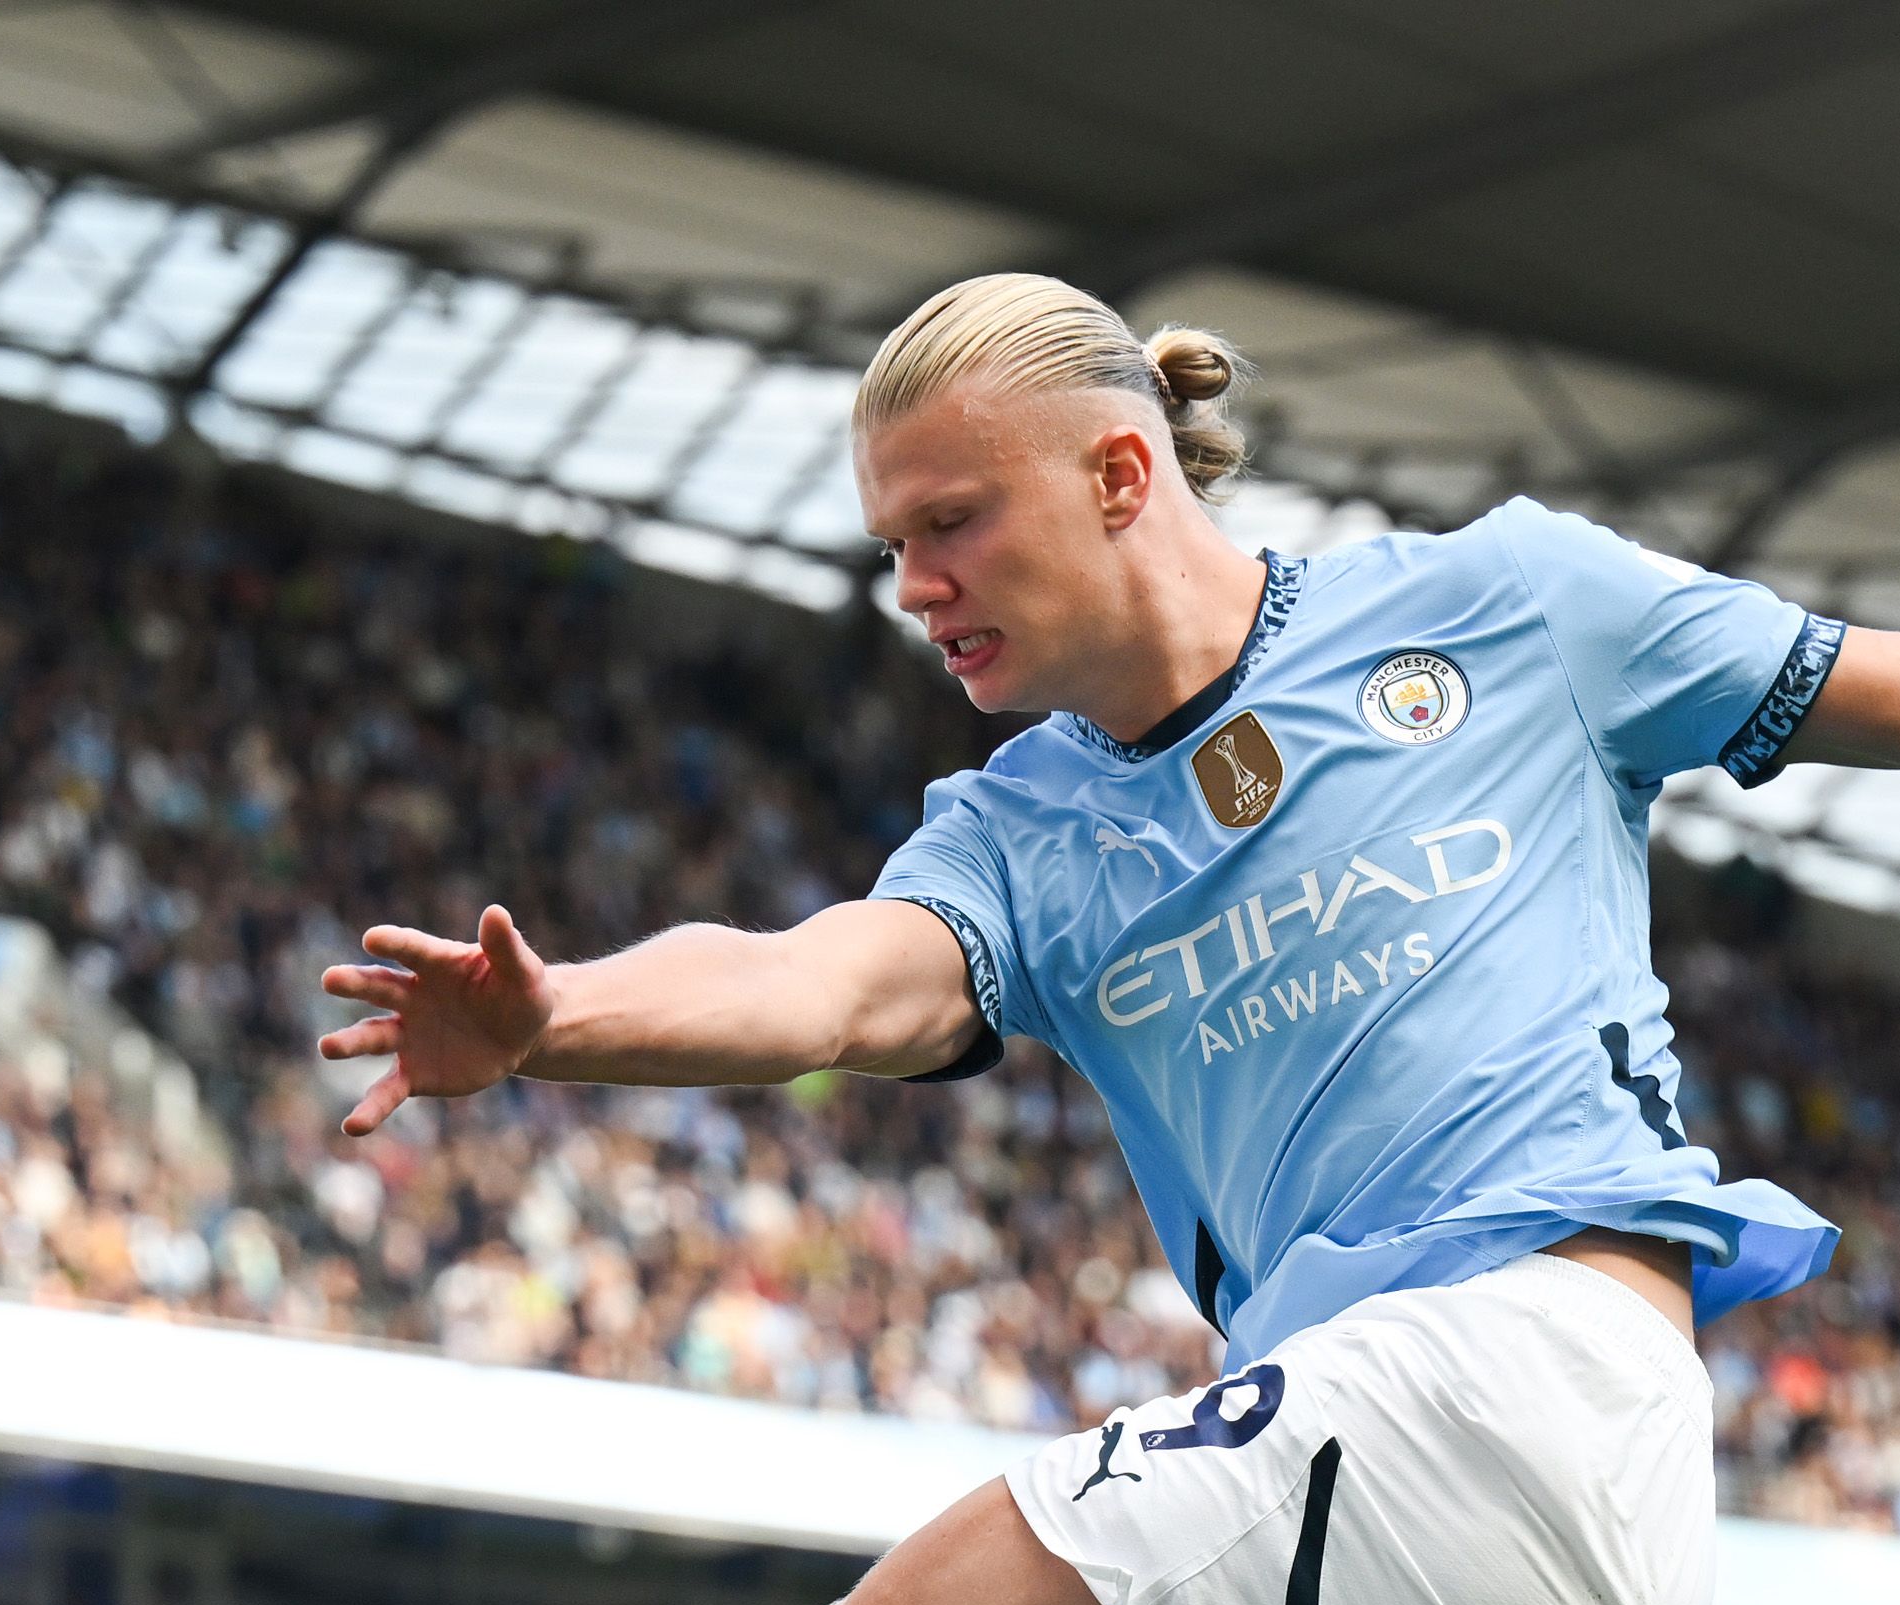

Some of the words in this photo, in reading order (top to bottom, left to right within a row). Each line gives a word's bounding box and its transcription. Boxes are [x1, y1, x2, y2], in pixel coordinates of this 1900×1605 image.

[1366, 657, 1449, 701] MANCHESTER
[1413, 726, 1444, 741] CITY
[1234, 780, 1268, 812] FIFA
[1247, 800, 1266, 819] 2023
[1096, 818, 1513, 1027] ETIHAD
[1198, 932, 1435, 1065] AIRWAYS
[1139, 1364, 1286, 1449] 9
